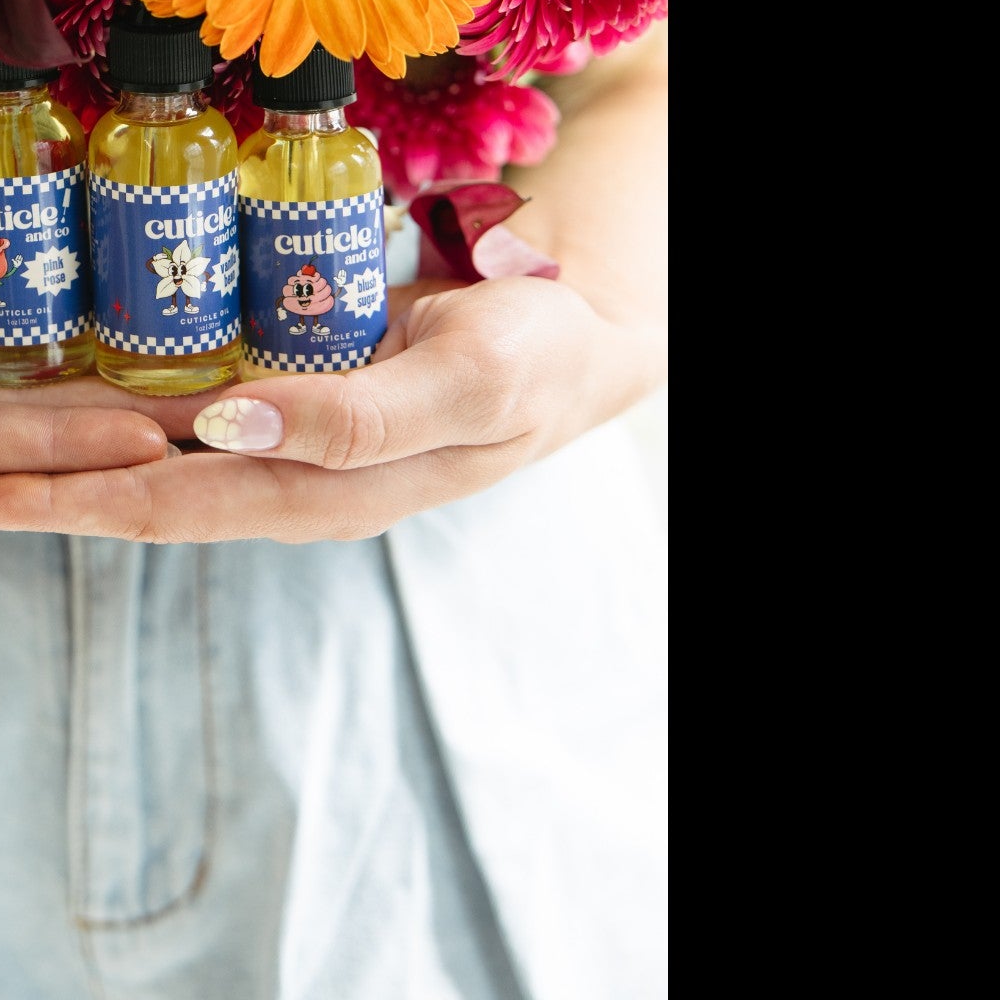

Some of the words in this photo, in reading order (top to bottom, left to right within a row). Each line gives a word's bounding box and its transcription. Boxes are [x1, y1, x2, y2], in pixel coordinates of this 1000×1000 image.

[25, 228, 52, 243] and
[54, 226, 70, 238] co
[213, 228, 230, 247] and
[229, 224, 237, 238] co
[344, 249, 367, 265] and
[368, 247, 380, 260] co
[42, 256, 65, 275] pink
[43, 272, 66, 287] rose
[357, 276, 377, 293] blush
[357, 291, 378, 309] sugar
[36, 307, 51, 315] OIL
[180, 312, 218, 325] CUTICLE
[219, 307, 230, 317] OIL
[310, 327, 351, 343] CUTICLE
[353, 329, 367, 338] OIL
